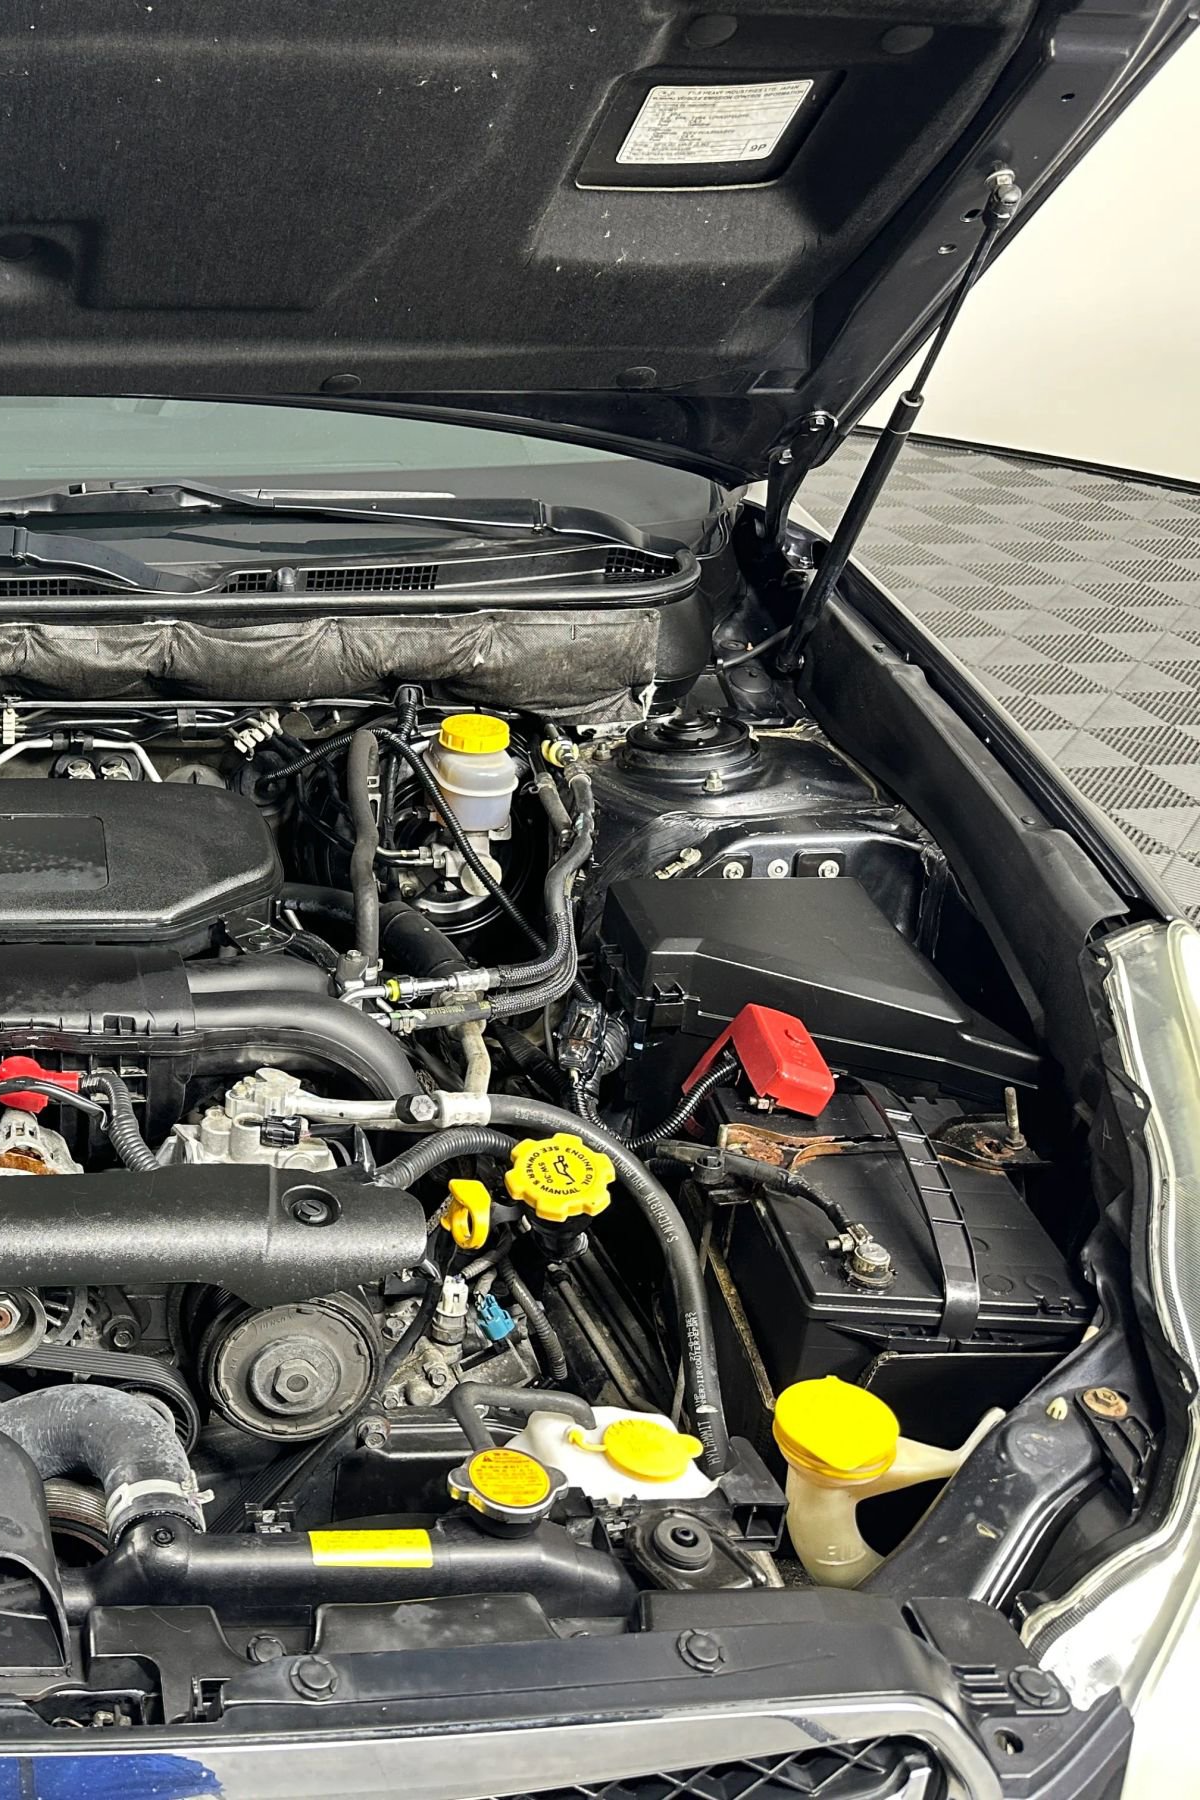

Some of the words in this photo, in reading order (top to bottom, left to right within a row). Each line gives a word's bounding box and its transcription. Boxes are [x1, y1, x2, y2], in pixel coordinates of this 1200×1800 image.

[750, 143, 768, 152] 9P
[540, 1146, 560, 1154] SEE
[565, 1147, 594, 1172] ENGINE
[581, 1174, 593, 1185] OIL
[538, 1161, 554, 1184] 5W-30
[540, 1184, 581, 1195] MANUAL
